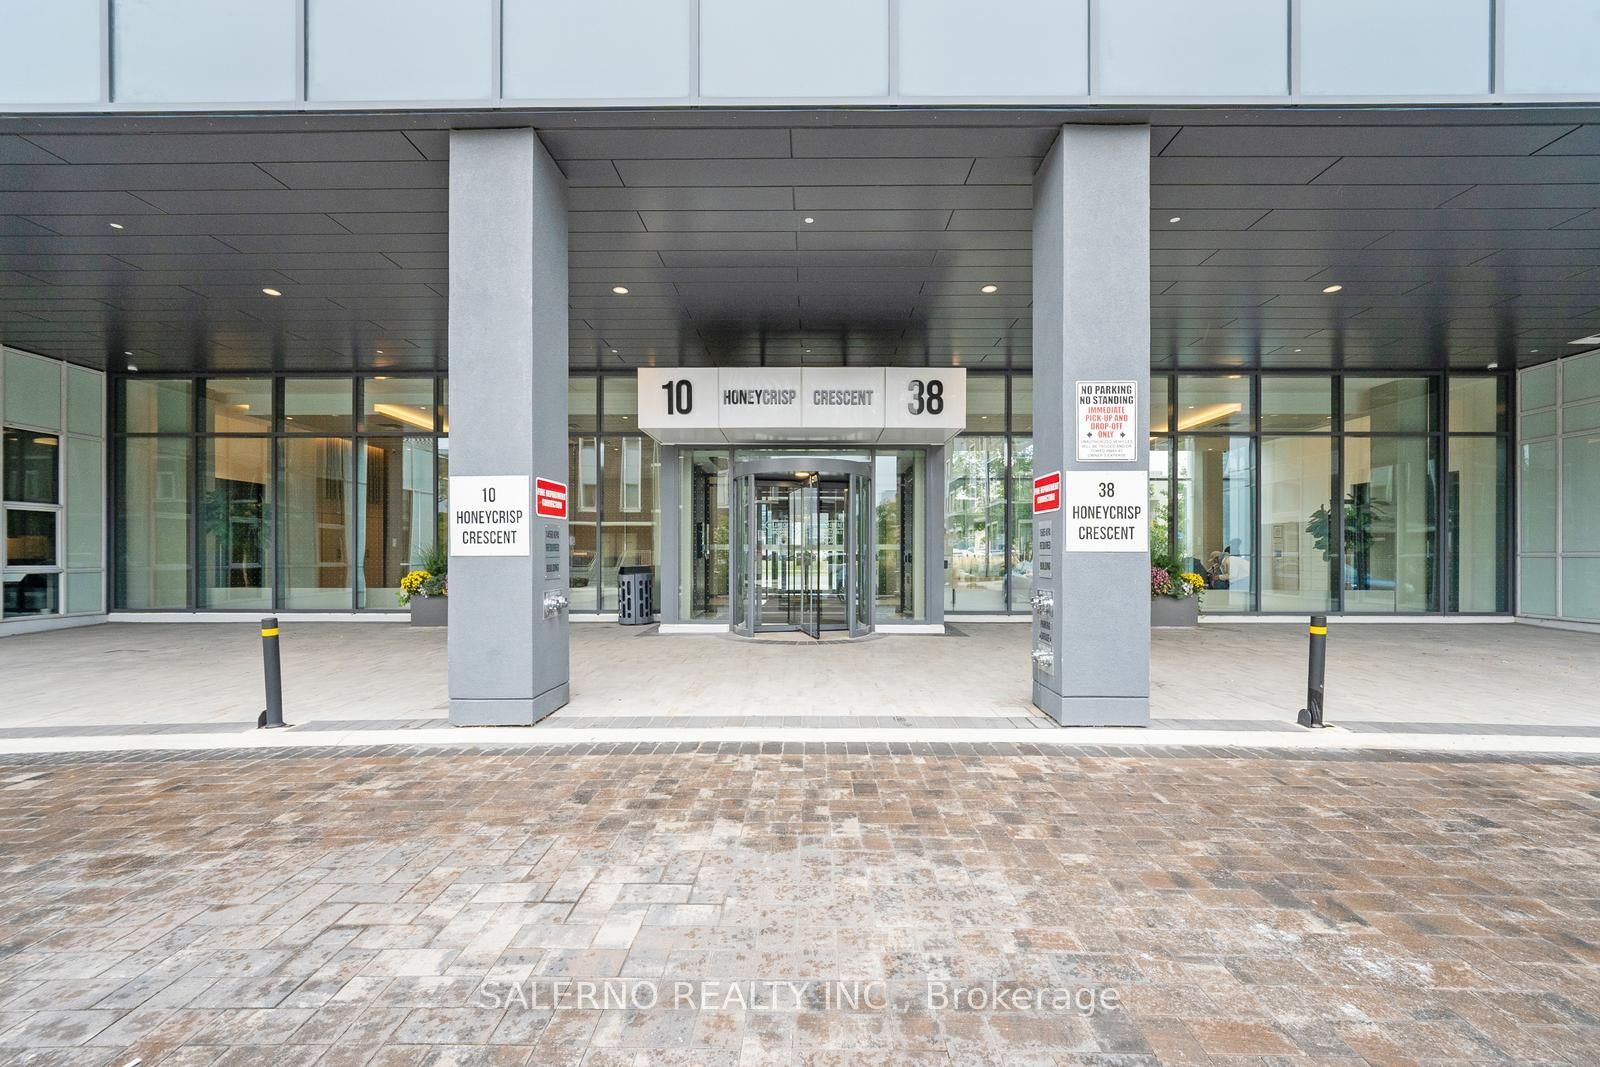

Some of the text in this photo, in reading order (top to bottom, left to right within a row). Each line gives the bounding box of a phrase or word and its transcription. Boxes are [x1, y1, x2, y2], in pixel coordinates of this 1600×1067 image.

[661, 379, 944, 415] 10 HONEYCRISP CRESCENT 38
[1081, 385, 1132, 395] NO PARKING
[1079, 395, 1134, 405] NO STANDING
[1088, 406, 1125, 414] IMMEDIATE
[1114, 414, 1129, 422] AND
[1097, 430, 1114, 439] ONLY
[482, 487, 496, 503] 10
[1098, 482, 1115, 498] 38
[456, 510, 523, 524] HONEYCRISP
[1072, 505, 1142, 520] HONEYCRISP
[462, 530, 518, 545] CRESCENT
[1078, 526, 1136, 540] CRESCENT
